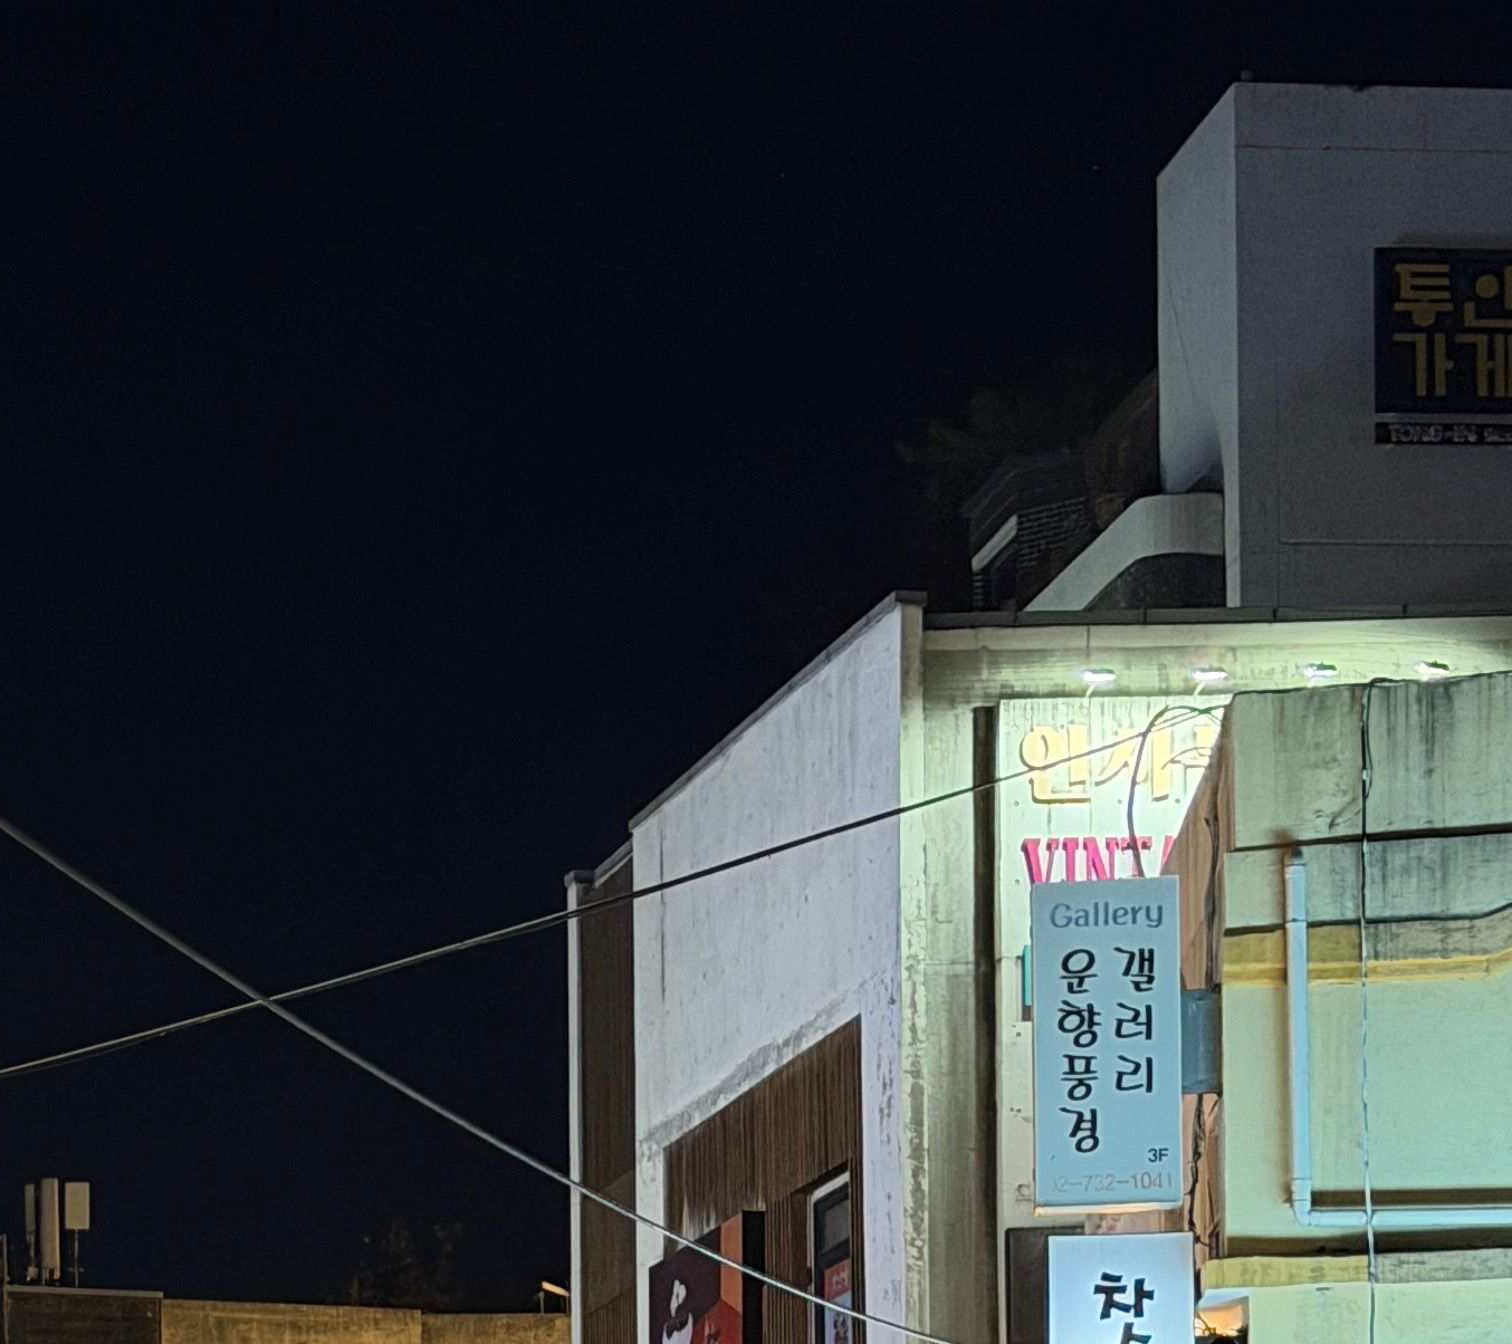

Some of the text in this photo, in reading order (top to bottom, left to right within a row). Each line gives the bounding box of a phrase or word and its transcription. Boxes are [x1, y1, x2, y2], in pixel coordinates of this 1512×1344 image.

[1049, 900, 1164, 930] Gallery
[1056, 947, 1102, 1155] 운향풍경
[1112, 945, 1156, 1096] 갤러리
[1147, 1147, 1169, 1163] 3F
